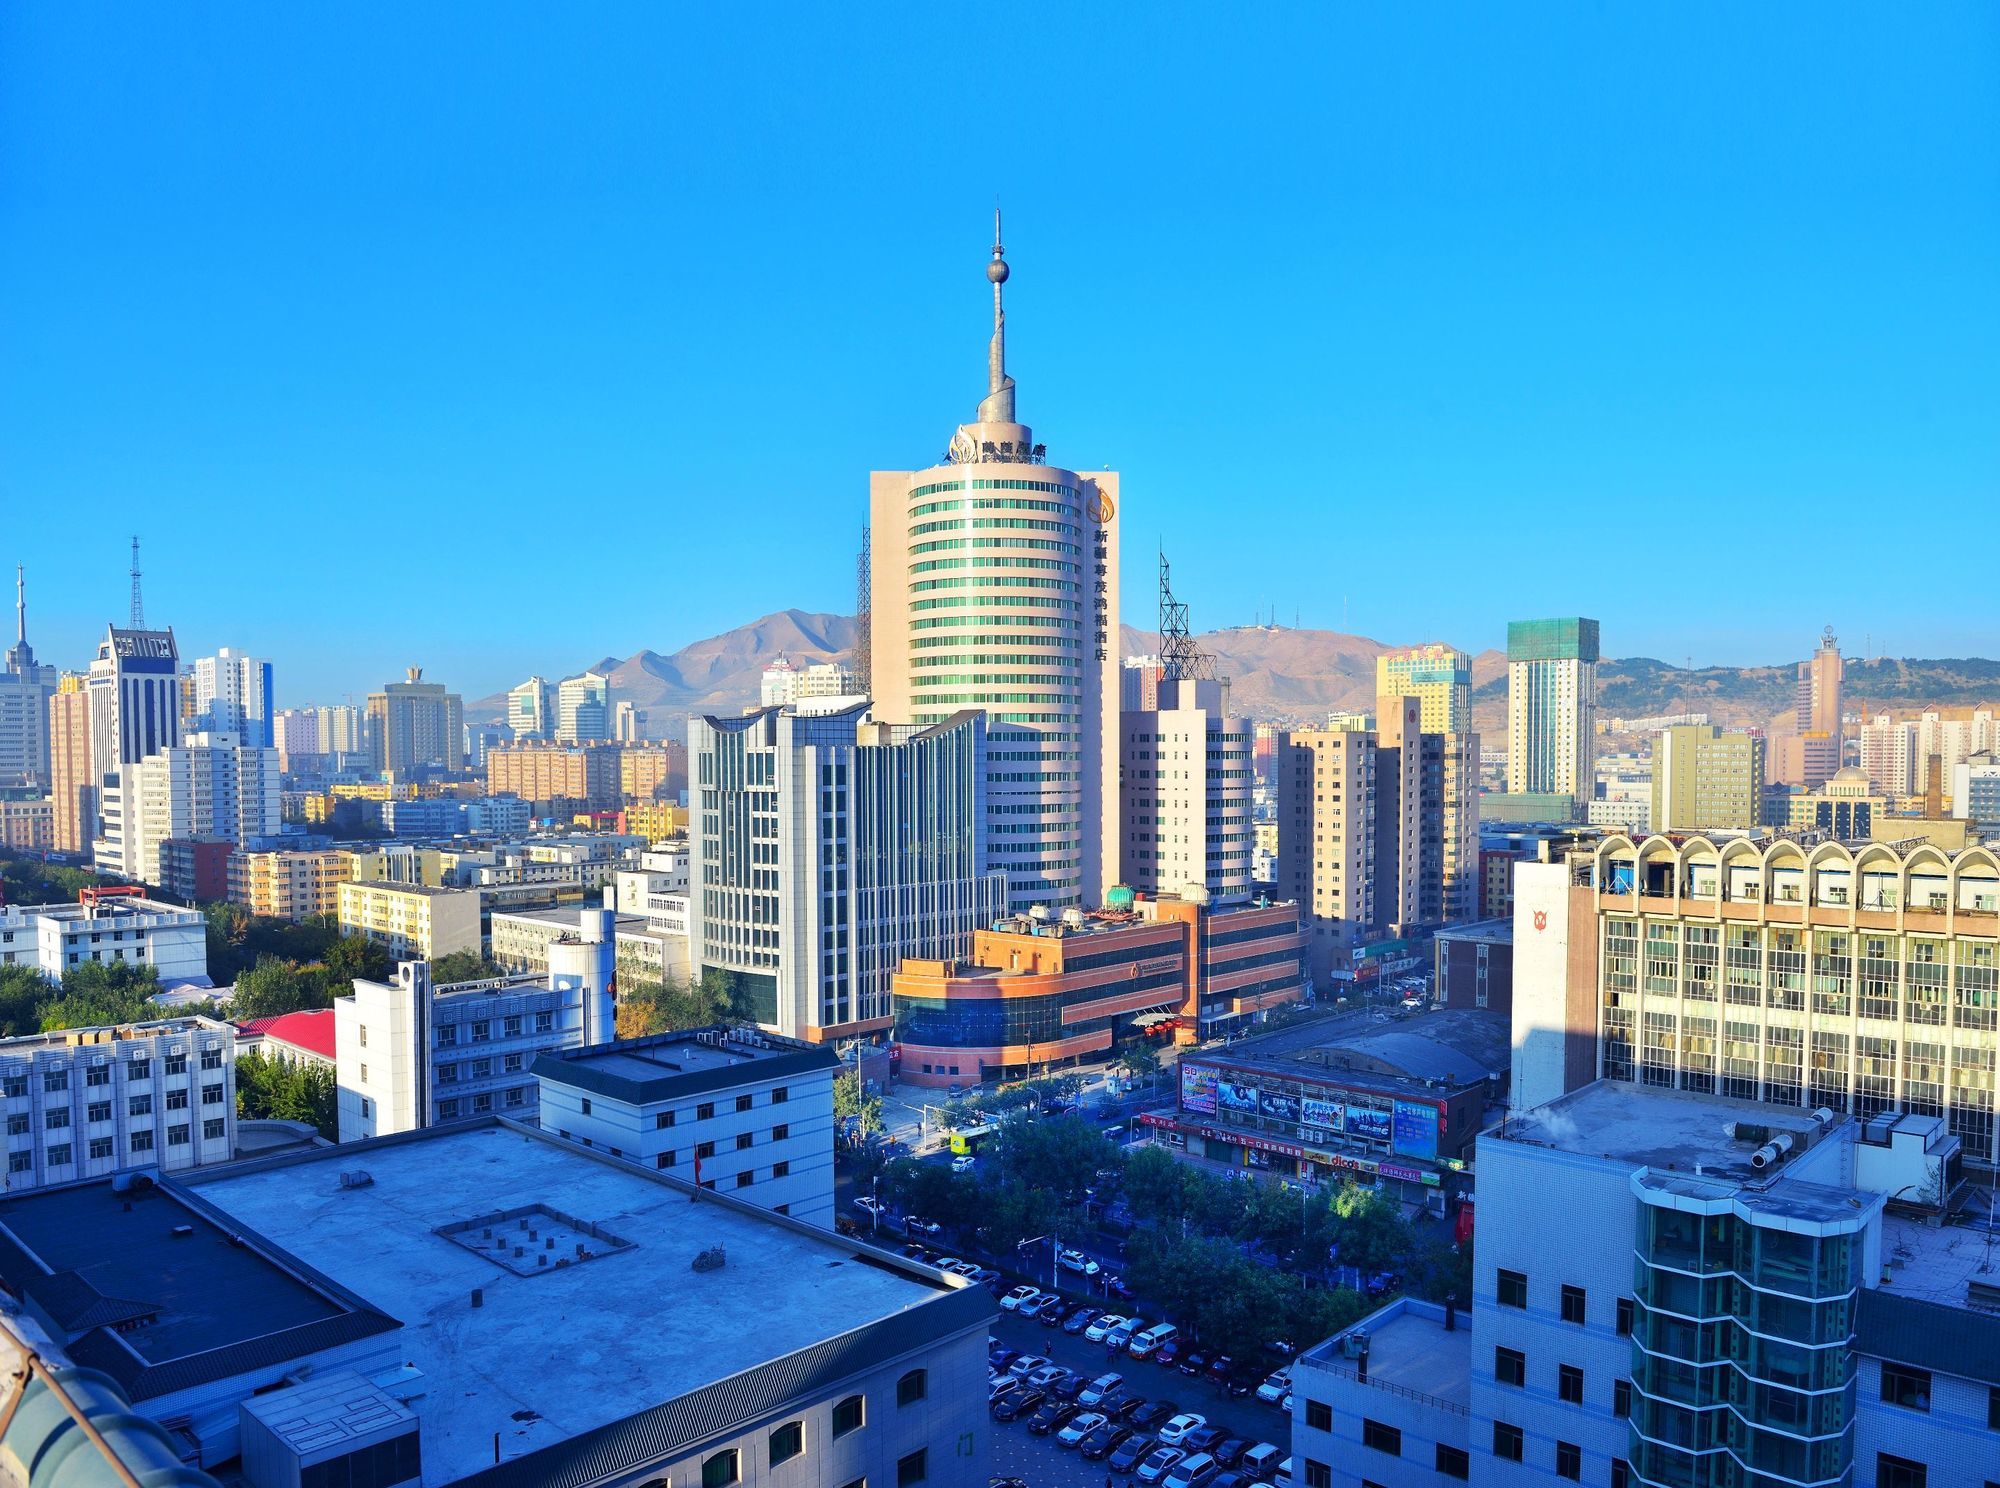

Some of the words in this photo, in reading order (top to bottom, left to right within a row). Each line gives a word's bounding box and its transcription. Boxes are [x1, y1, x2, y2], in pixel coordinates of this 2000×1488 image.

[1094, 530, 1108, 661] 新疆尊茂鸿福酒店
